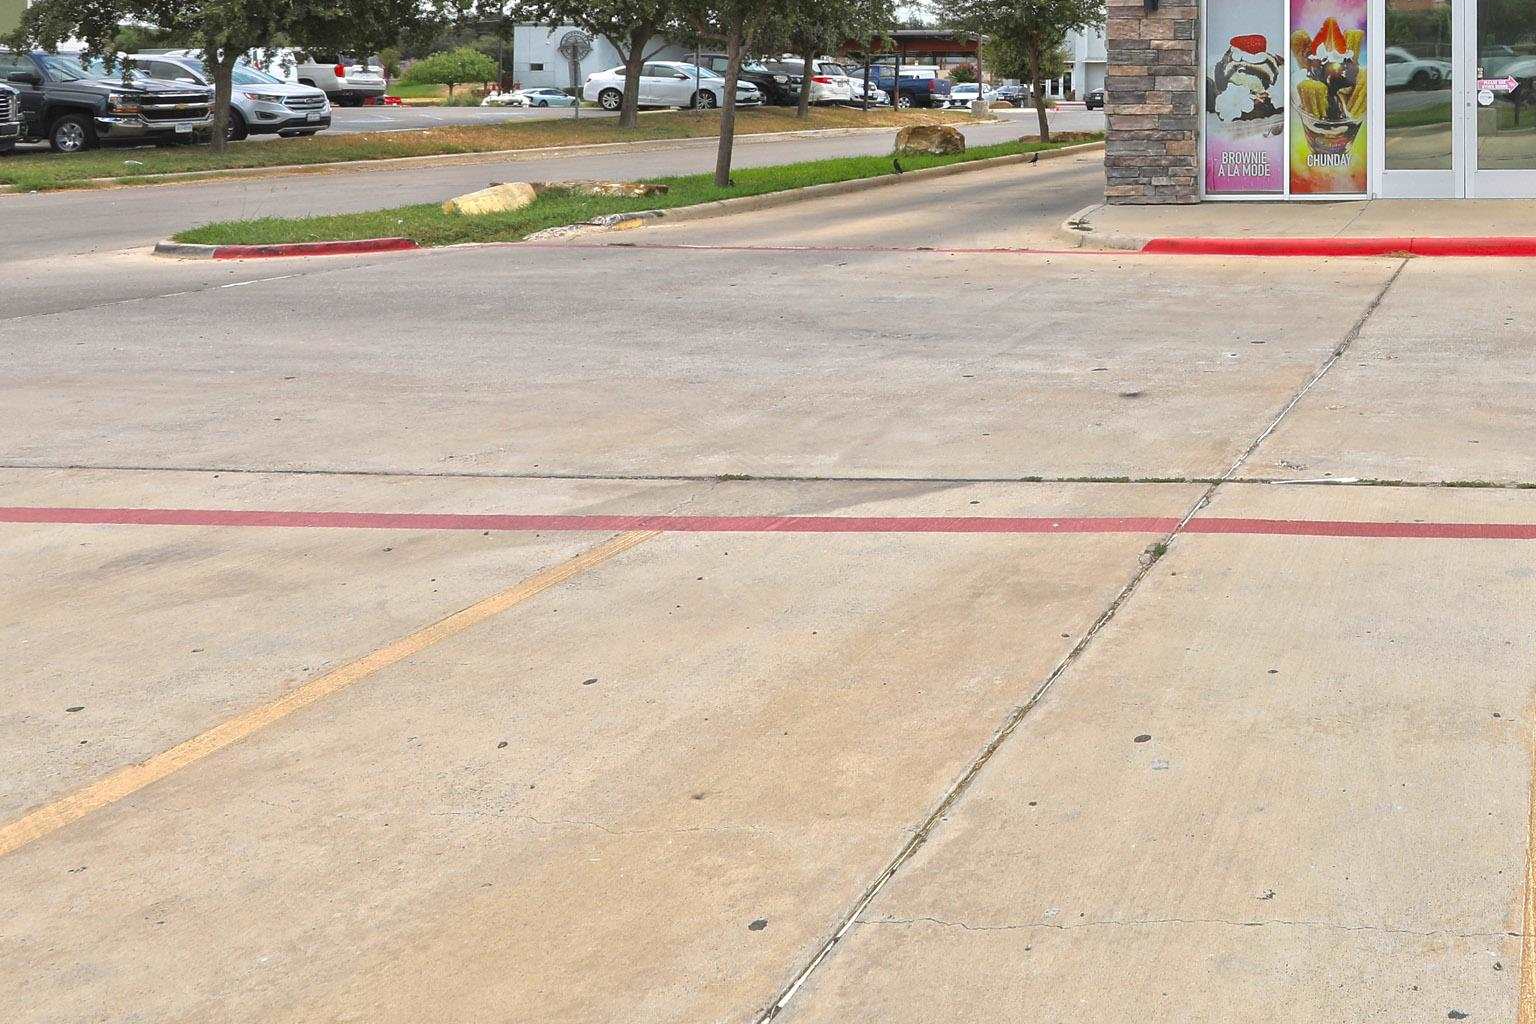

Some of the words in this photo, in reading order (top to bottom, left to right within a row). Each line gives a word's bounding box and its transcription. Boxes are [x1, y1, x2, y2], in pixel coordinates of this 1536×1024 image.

[1222, 152, 1267, 164] BROWNIE
[1307, 154, 1351, 167] CHUNDAY
[1228, 164, 1240, 176] LA
[1242, 164, 1271, 177] MODE
